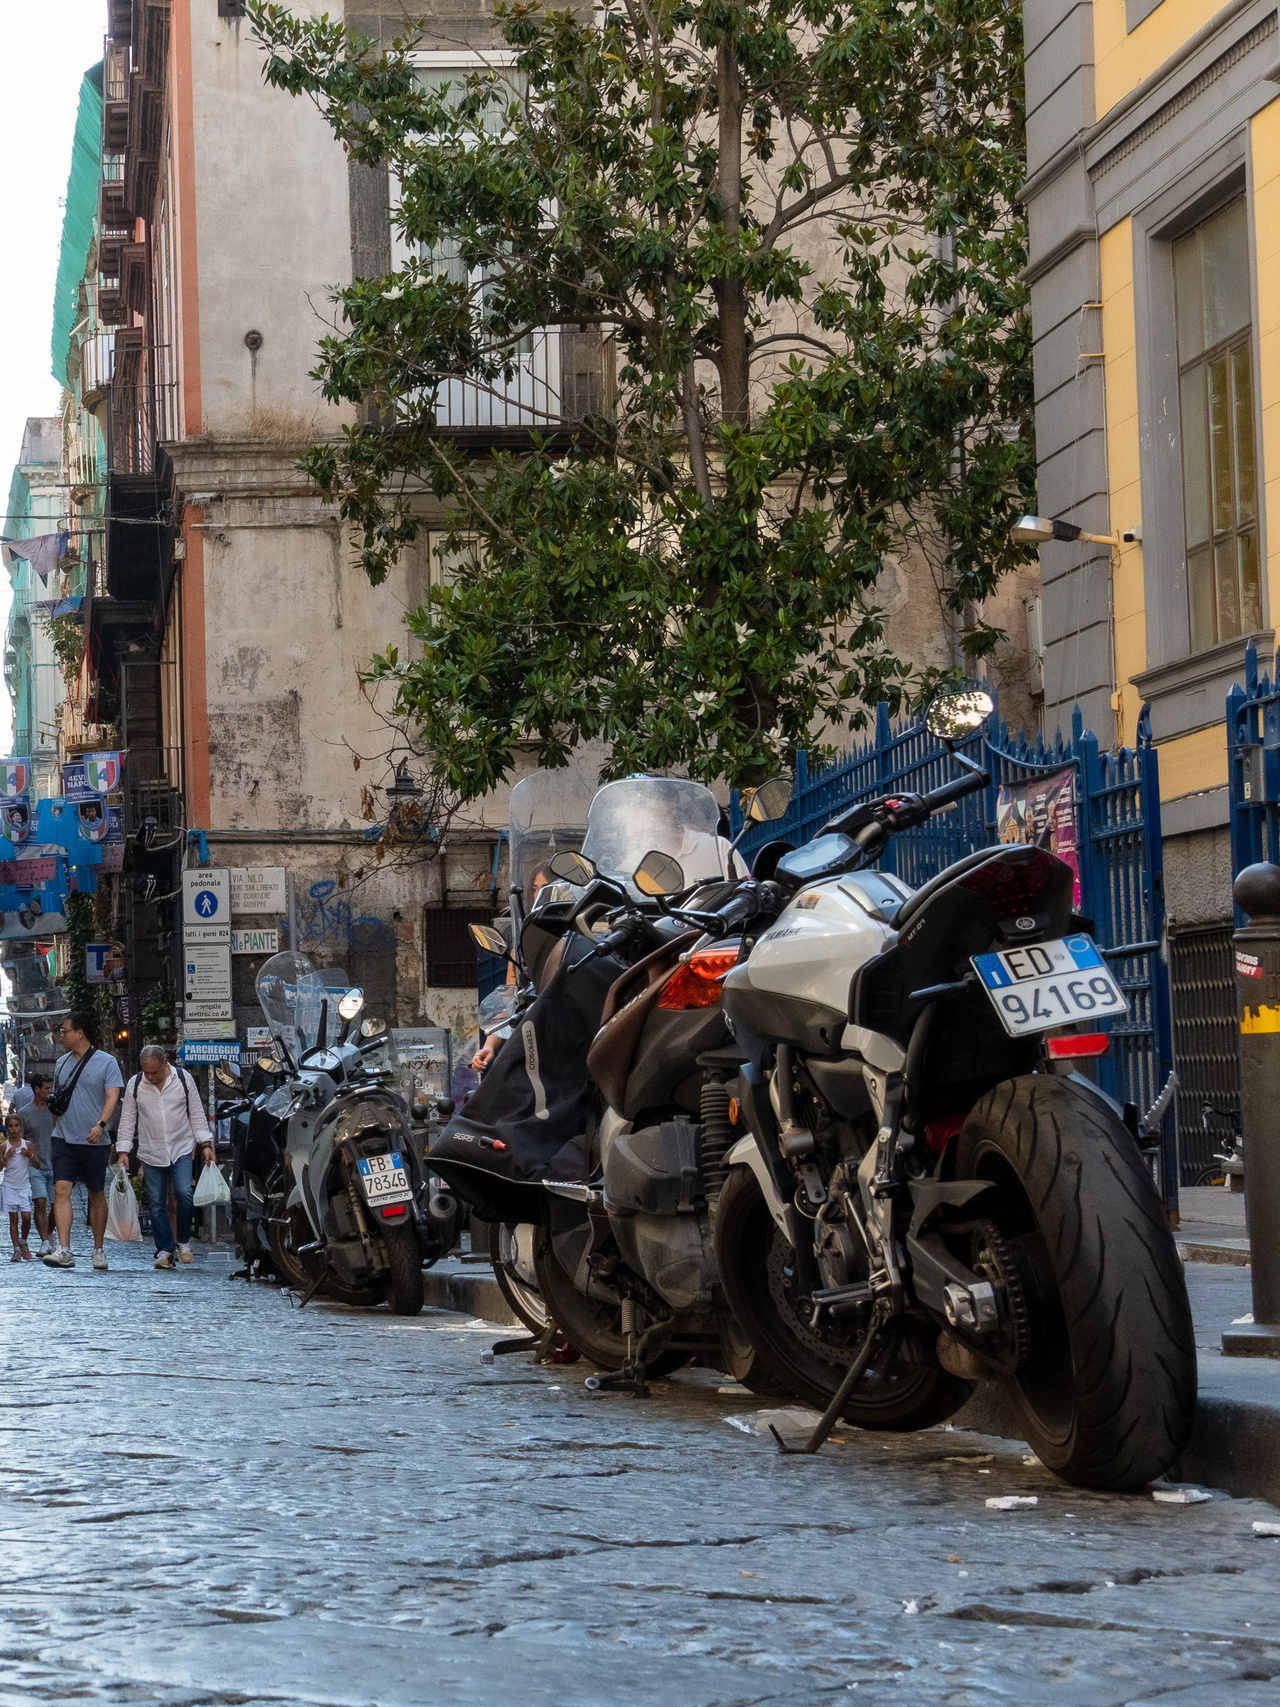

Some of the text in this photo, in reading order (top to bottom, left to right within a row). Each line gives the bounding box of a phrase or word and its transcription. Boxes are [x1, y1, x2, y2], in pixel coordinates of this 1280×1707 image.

[67, 780, 88, 788] NAPO
[190, 880, 221, 888] pedonale
[232, 874, 263, 883] VIA NILO
[906, 918, 926, 941] MT-07
[244, 932, 276, 949] PIANTE
[1003, 947, 1055, 980] ED
[1002, 976, 1118, 1025] 94169
[185, 1045, 240, 1054] PARCHEGGIO
[368, 1157, 387, 1173] FB
[365, 1172, 407, 1194] 78346
[370, 1195, 388, 1203] CENTRO
[389, 1193, 403, 1201] MOTO
